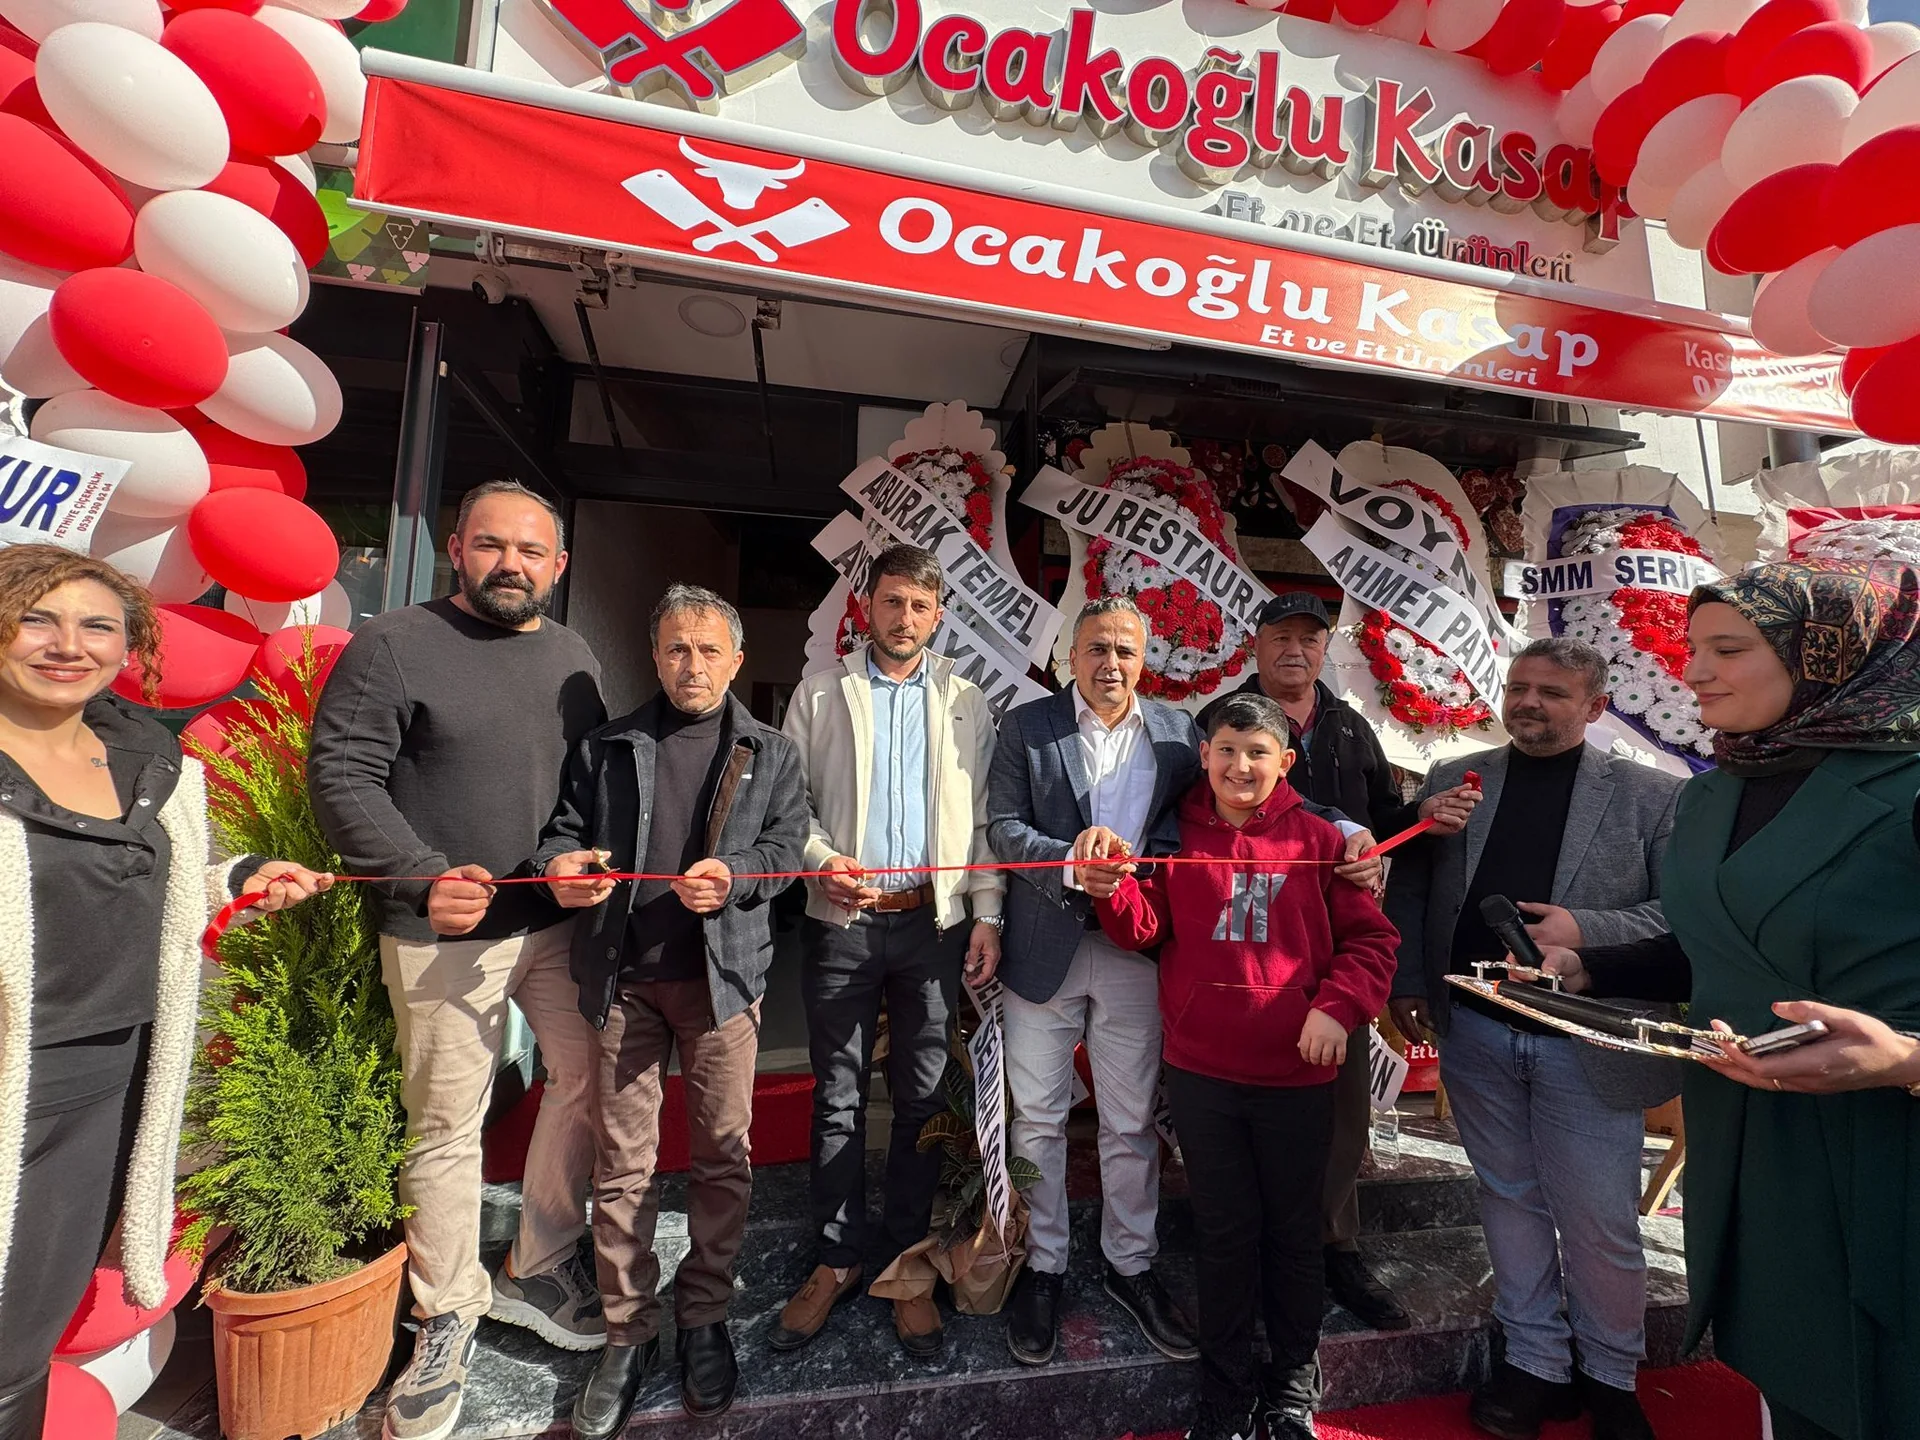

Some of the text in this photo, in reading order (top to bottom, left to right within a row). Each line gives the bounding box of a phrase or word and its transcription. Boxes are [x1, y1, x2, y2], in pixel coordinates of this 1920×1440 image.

[833, 0, 1350, 169] Ocakoğlu
[1226, 192, 1266, 224] Et
[1358, 213, 1396, 250] Et
[1412, 217, 1577, 284] Ürünleri
[879, 197, 1599, 378] Ocakoğlu Kasap
[1259, 325, 1538, 385] Et ve Et Ürünleri
[54, 471, 105, 539] FETHİYE ÇİÇEKÇİLİK
[77, 516, 95, 533] 0539
[1057, 487, 1104, 526] JU
[946, 542, 1039, 646] TEMEL
[1327, 545, 1449, 629] AHMET
[1521, 561, 1593, 595] SMM
[974, 1017, 1000, 1142] SELMAN
[1411, 1045, 1426, 1059] Et
